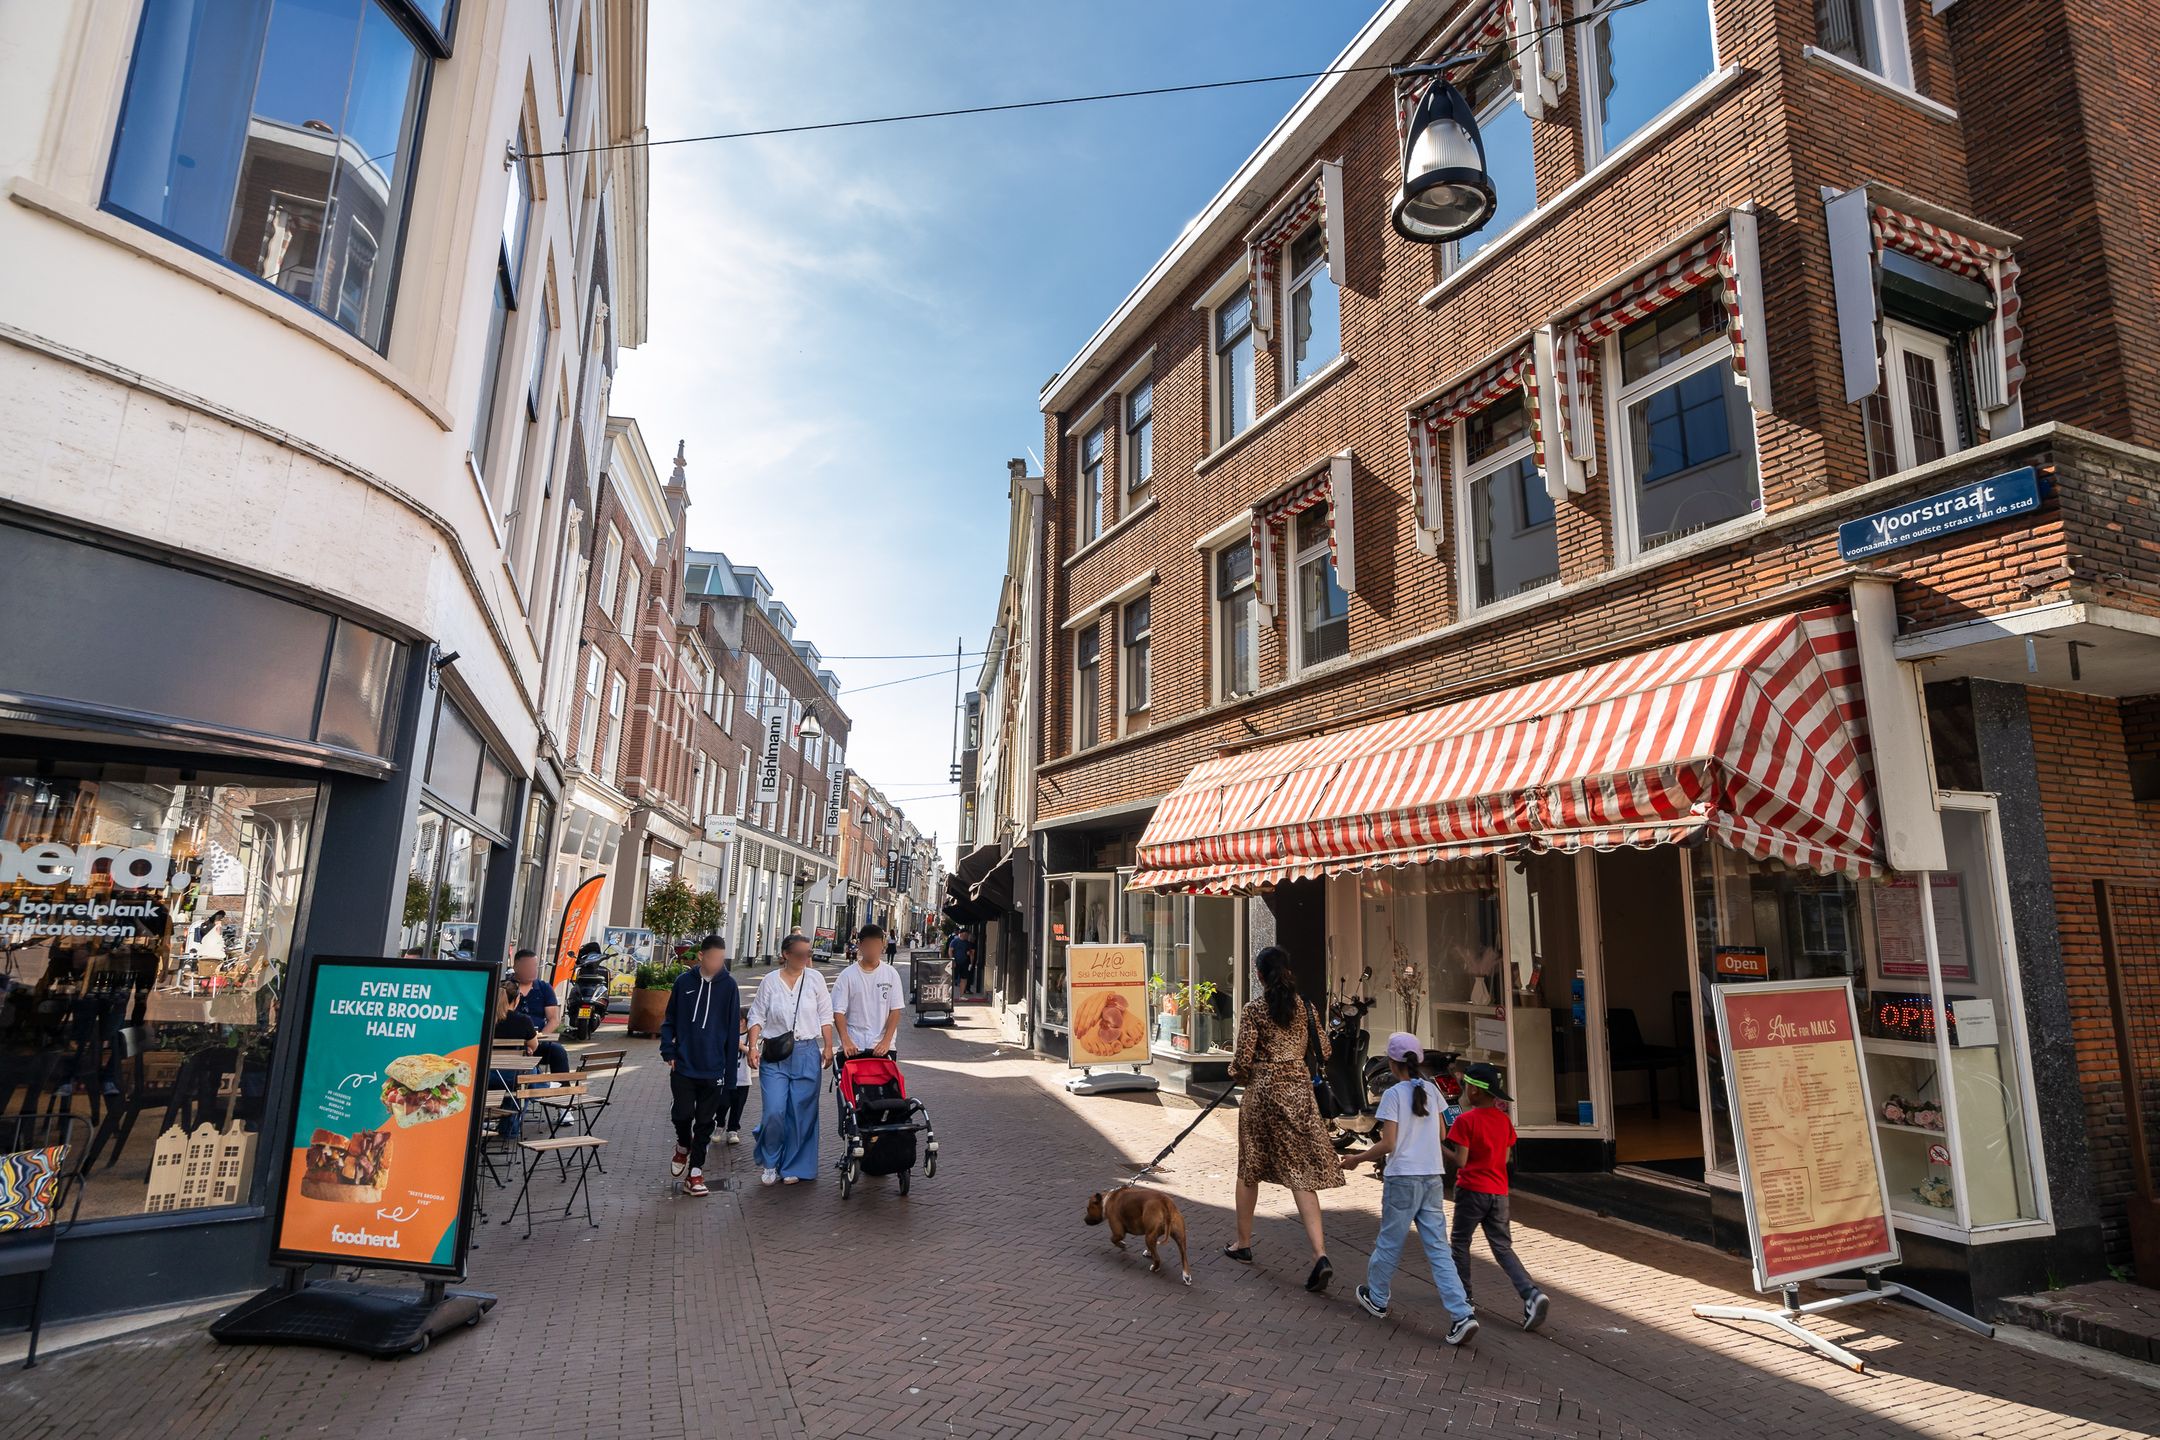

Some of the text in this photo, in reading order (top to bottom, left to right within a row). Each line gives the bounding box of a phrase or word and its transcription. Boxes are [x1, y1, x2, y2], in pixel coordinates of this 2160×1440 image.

[1871, 486, 1995, 534] Voorstraat
[1846, 497, 2033, 556] voornaamste en oudste straat van de stad
[762, 715, 782, 789] Bahlmann
[827, 770, 842, 825] Bahlmann
[19, 896, 159, 920] borrelplank
[1092, 969, 1118, 980] Perfect
[1119, 969, 1138, 977] Nails
[1725, 956, 1758, 972] Open
[360, 981, 431, 999] EVEN EEN
[329, 999, 458, 1021] LEKKER BROODJE
[366, 1021, 416, 1038] HALEN
[1798, 1026, 1810, 1037] FOR
[1809, 1019, 1837, 1037] NAILS
[331, 1224, 401, 1249] foodnerd.
